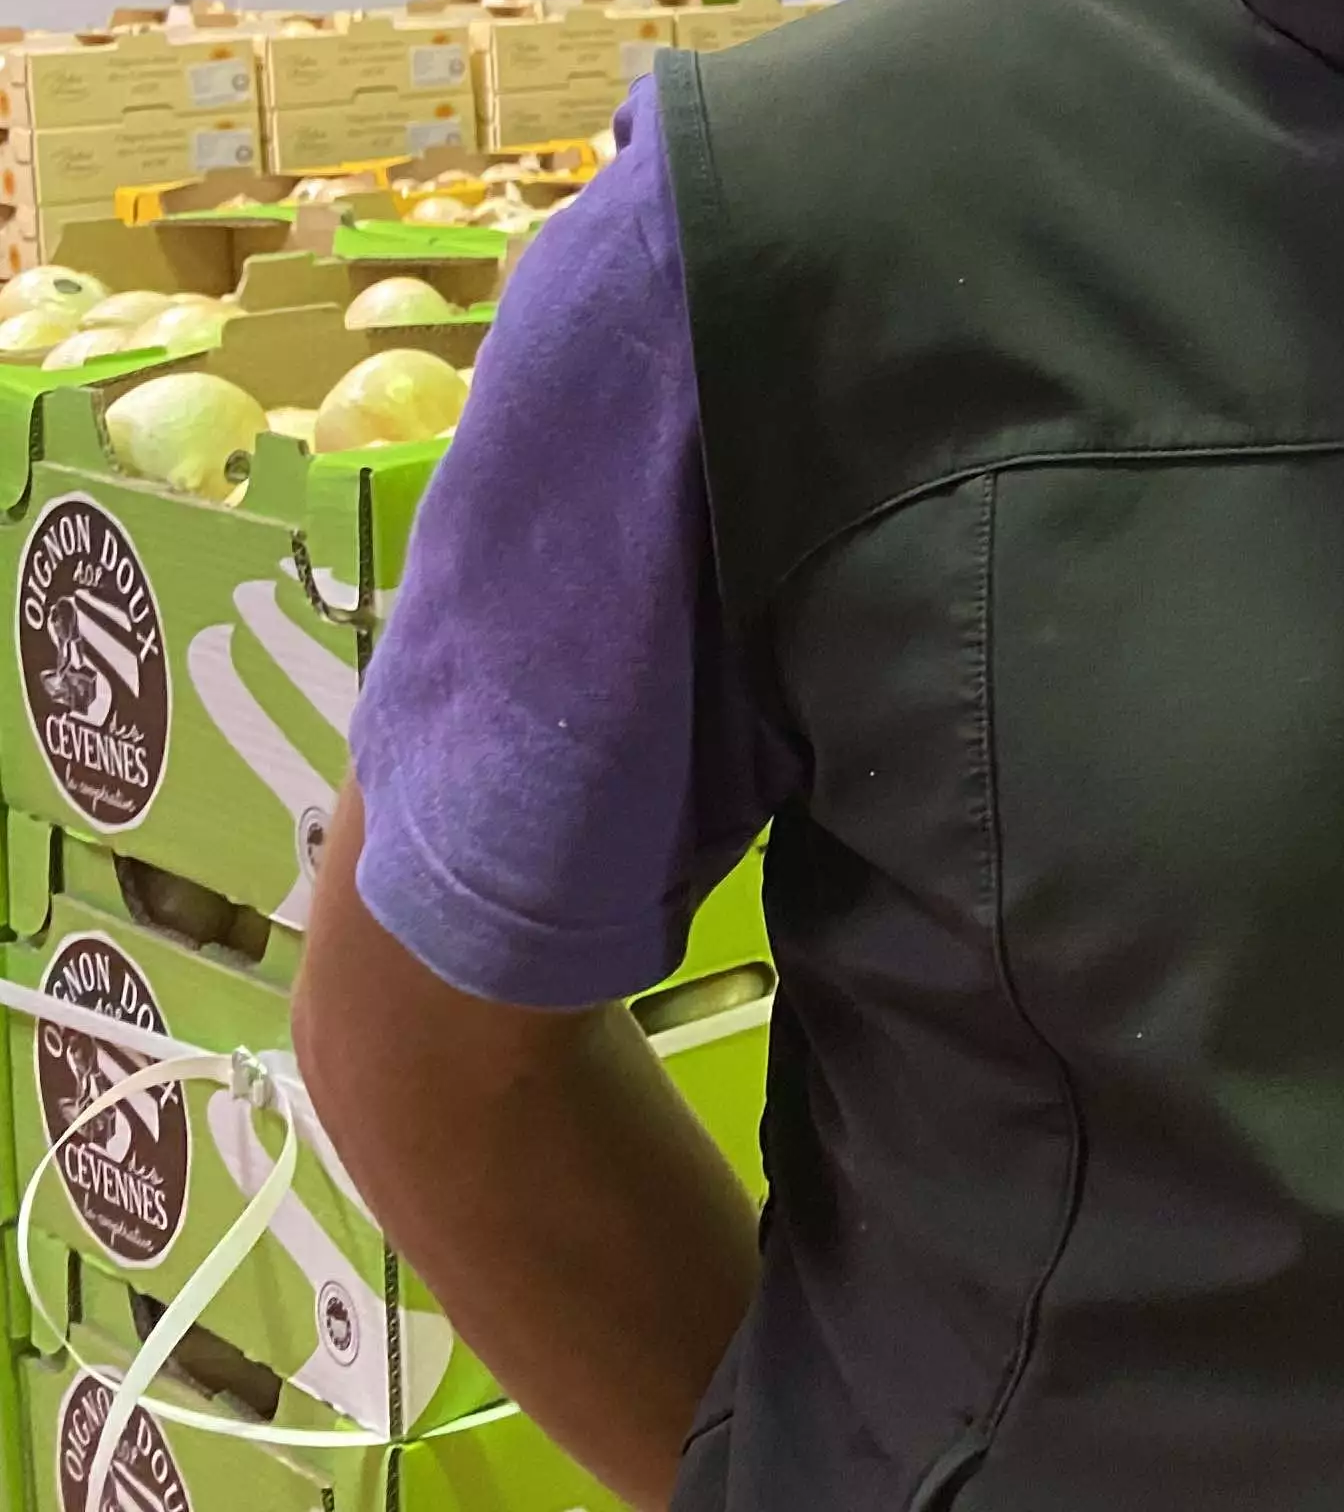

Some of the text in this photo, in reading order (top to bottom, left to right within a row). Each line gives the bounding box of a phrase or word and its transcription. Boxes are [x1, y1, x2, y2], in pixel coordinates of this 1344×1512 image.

[25, 514, 160, 664] OIGNON DOUX
[46, 710, 148, 790] CÉVENNES
[64, 1144, 168, 1232] CÉVENNES
